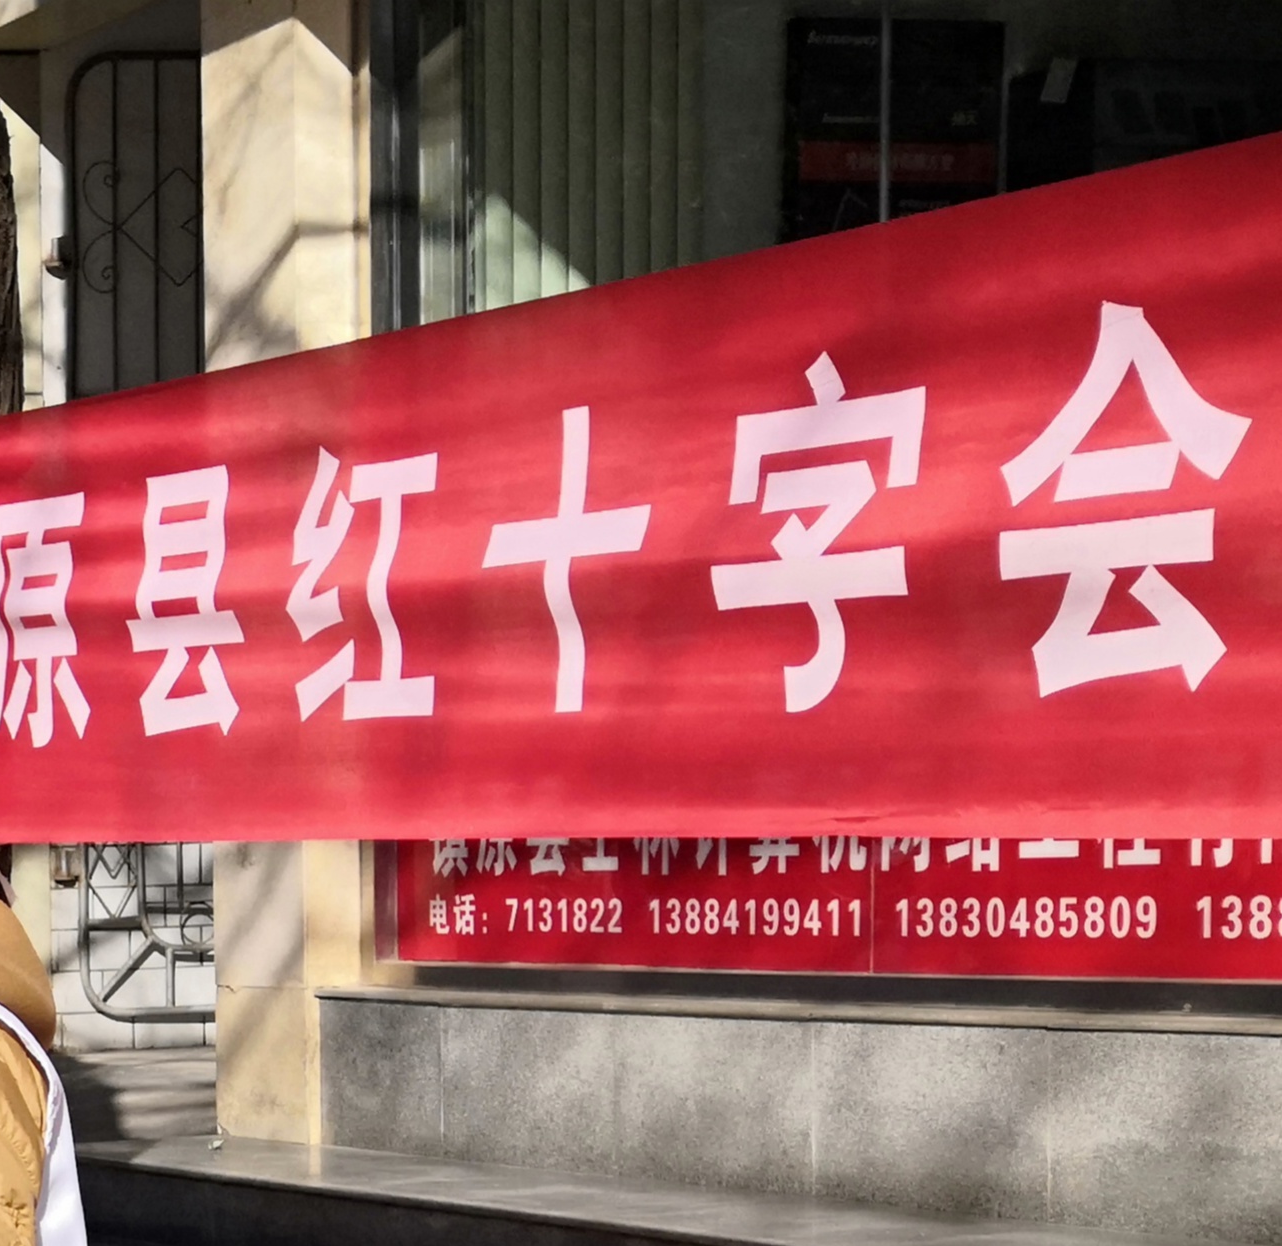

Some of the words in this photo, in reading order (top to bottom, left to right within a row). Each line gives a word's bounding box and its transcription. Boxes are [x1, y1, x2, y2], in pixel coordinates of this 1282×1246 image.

[505, 897, 623, 934] 7131822
[648, 896, 863, 937] 13884199411
[895, 896, 1158, 938] 13830485809
